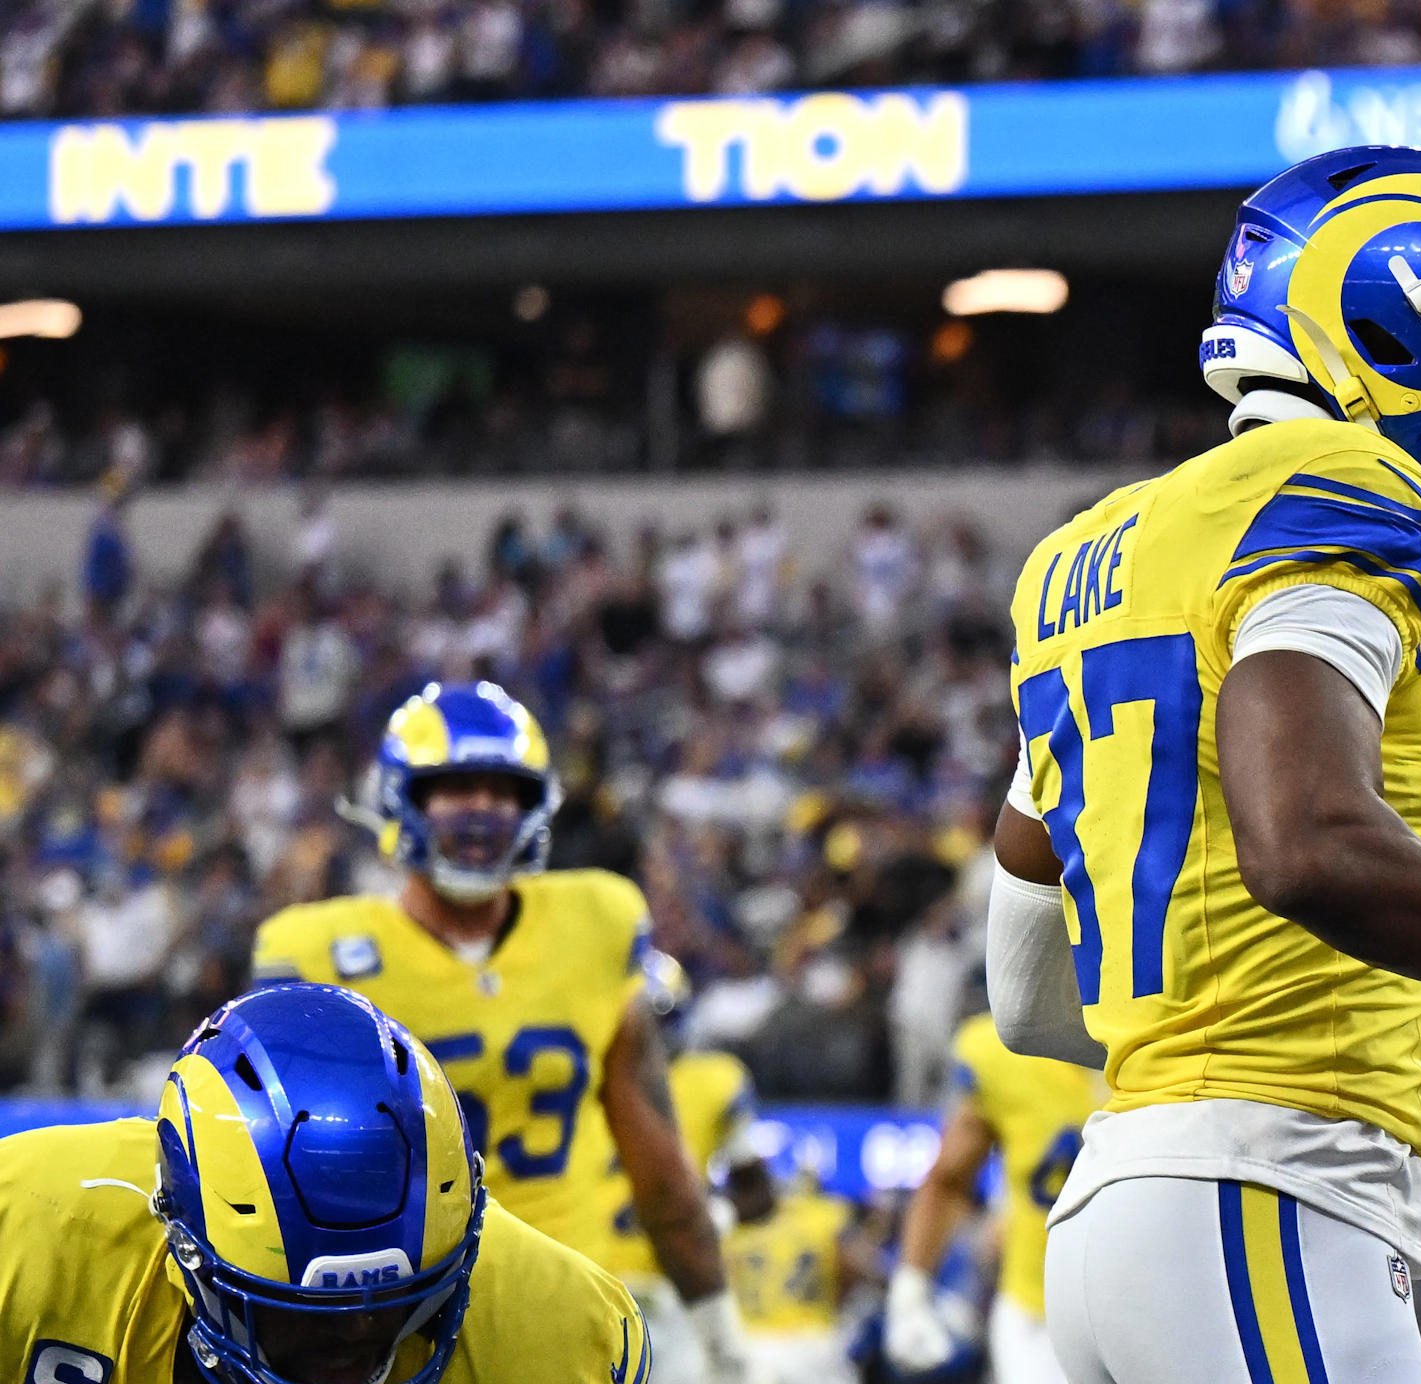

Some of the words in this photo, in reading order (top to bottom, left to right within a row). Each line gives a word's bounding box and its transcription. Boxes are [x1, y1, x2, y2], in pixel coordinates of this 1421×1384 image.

[656, 92, 967, 204] TION
[1037, 512, 1139, 642] LAKE
[323, 1264, 399, 1288] RAMS
